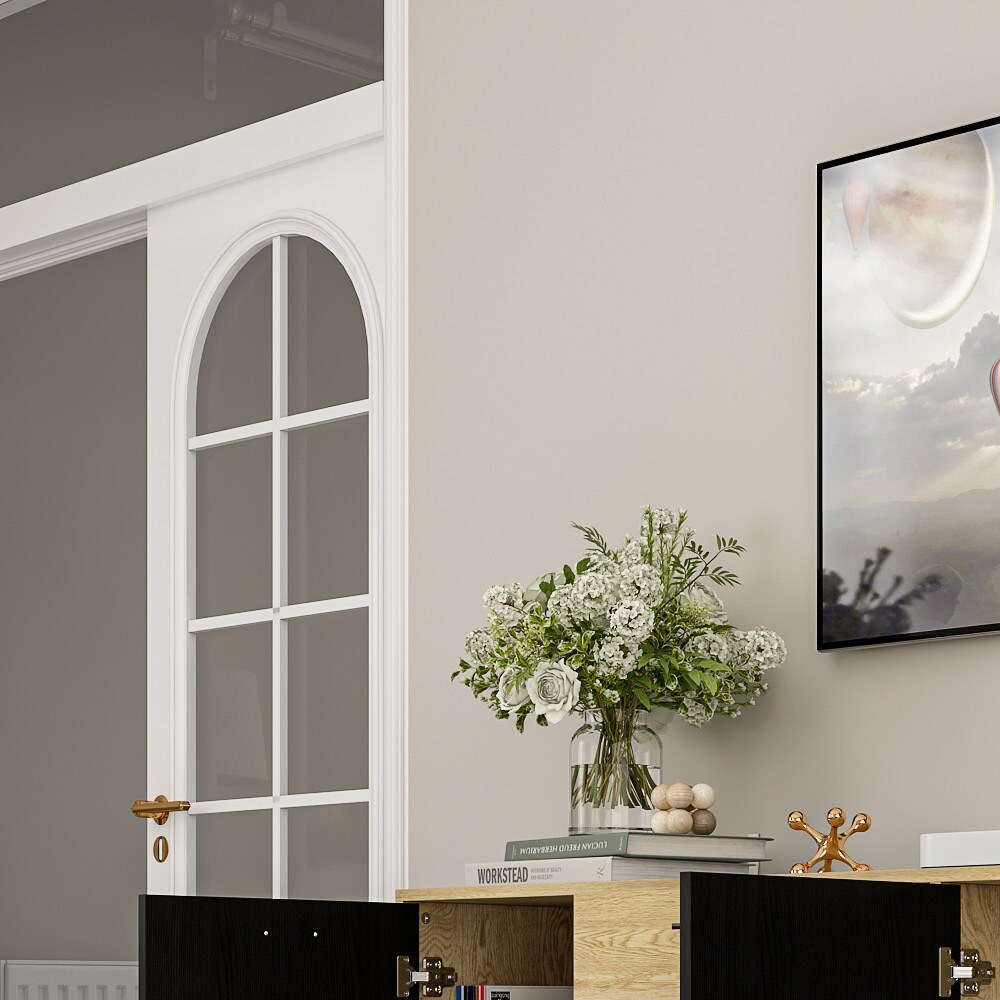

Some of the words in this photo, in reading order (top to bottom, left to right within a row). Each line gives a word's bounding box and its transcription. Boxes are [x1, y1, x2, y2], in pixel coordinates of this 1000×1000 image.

[520, 845, 558, 855] HERBARIUM
[559, 843, 581, 852] FREUD
[582, 841, 607, 851] LUCIAN
[477, 867, 528, 885] WORKSTEAD
